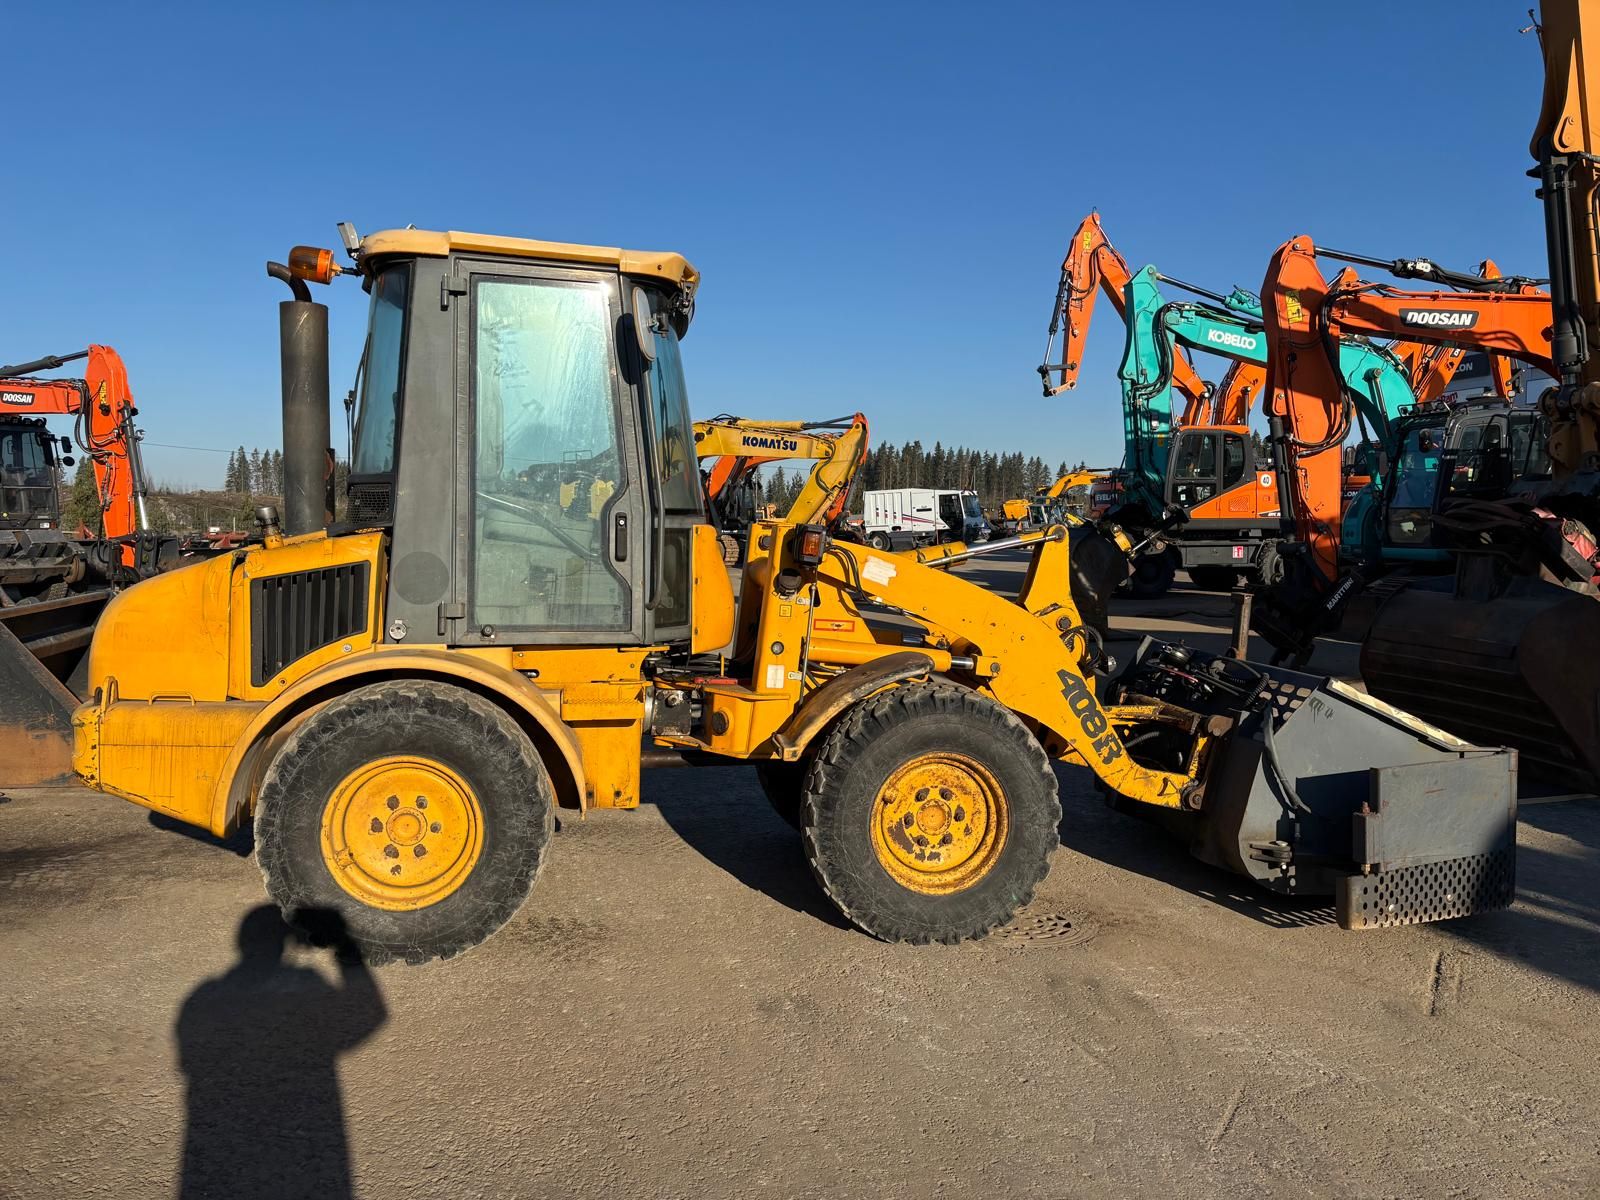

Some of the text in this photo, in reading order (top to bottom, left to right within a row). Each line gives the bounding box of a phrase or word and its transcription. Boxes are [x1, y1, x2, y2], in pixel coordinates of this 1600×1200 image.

[1406, 311, 1473, 326] DOOSAN
[1207, 328, 1257, 350] KOBELCO
[2, 393, 33, 403] DOOSAN
[742, 435, 798, 451] KOMATSU
[1056, 669, 1122, 765] 408R
